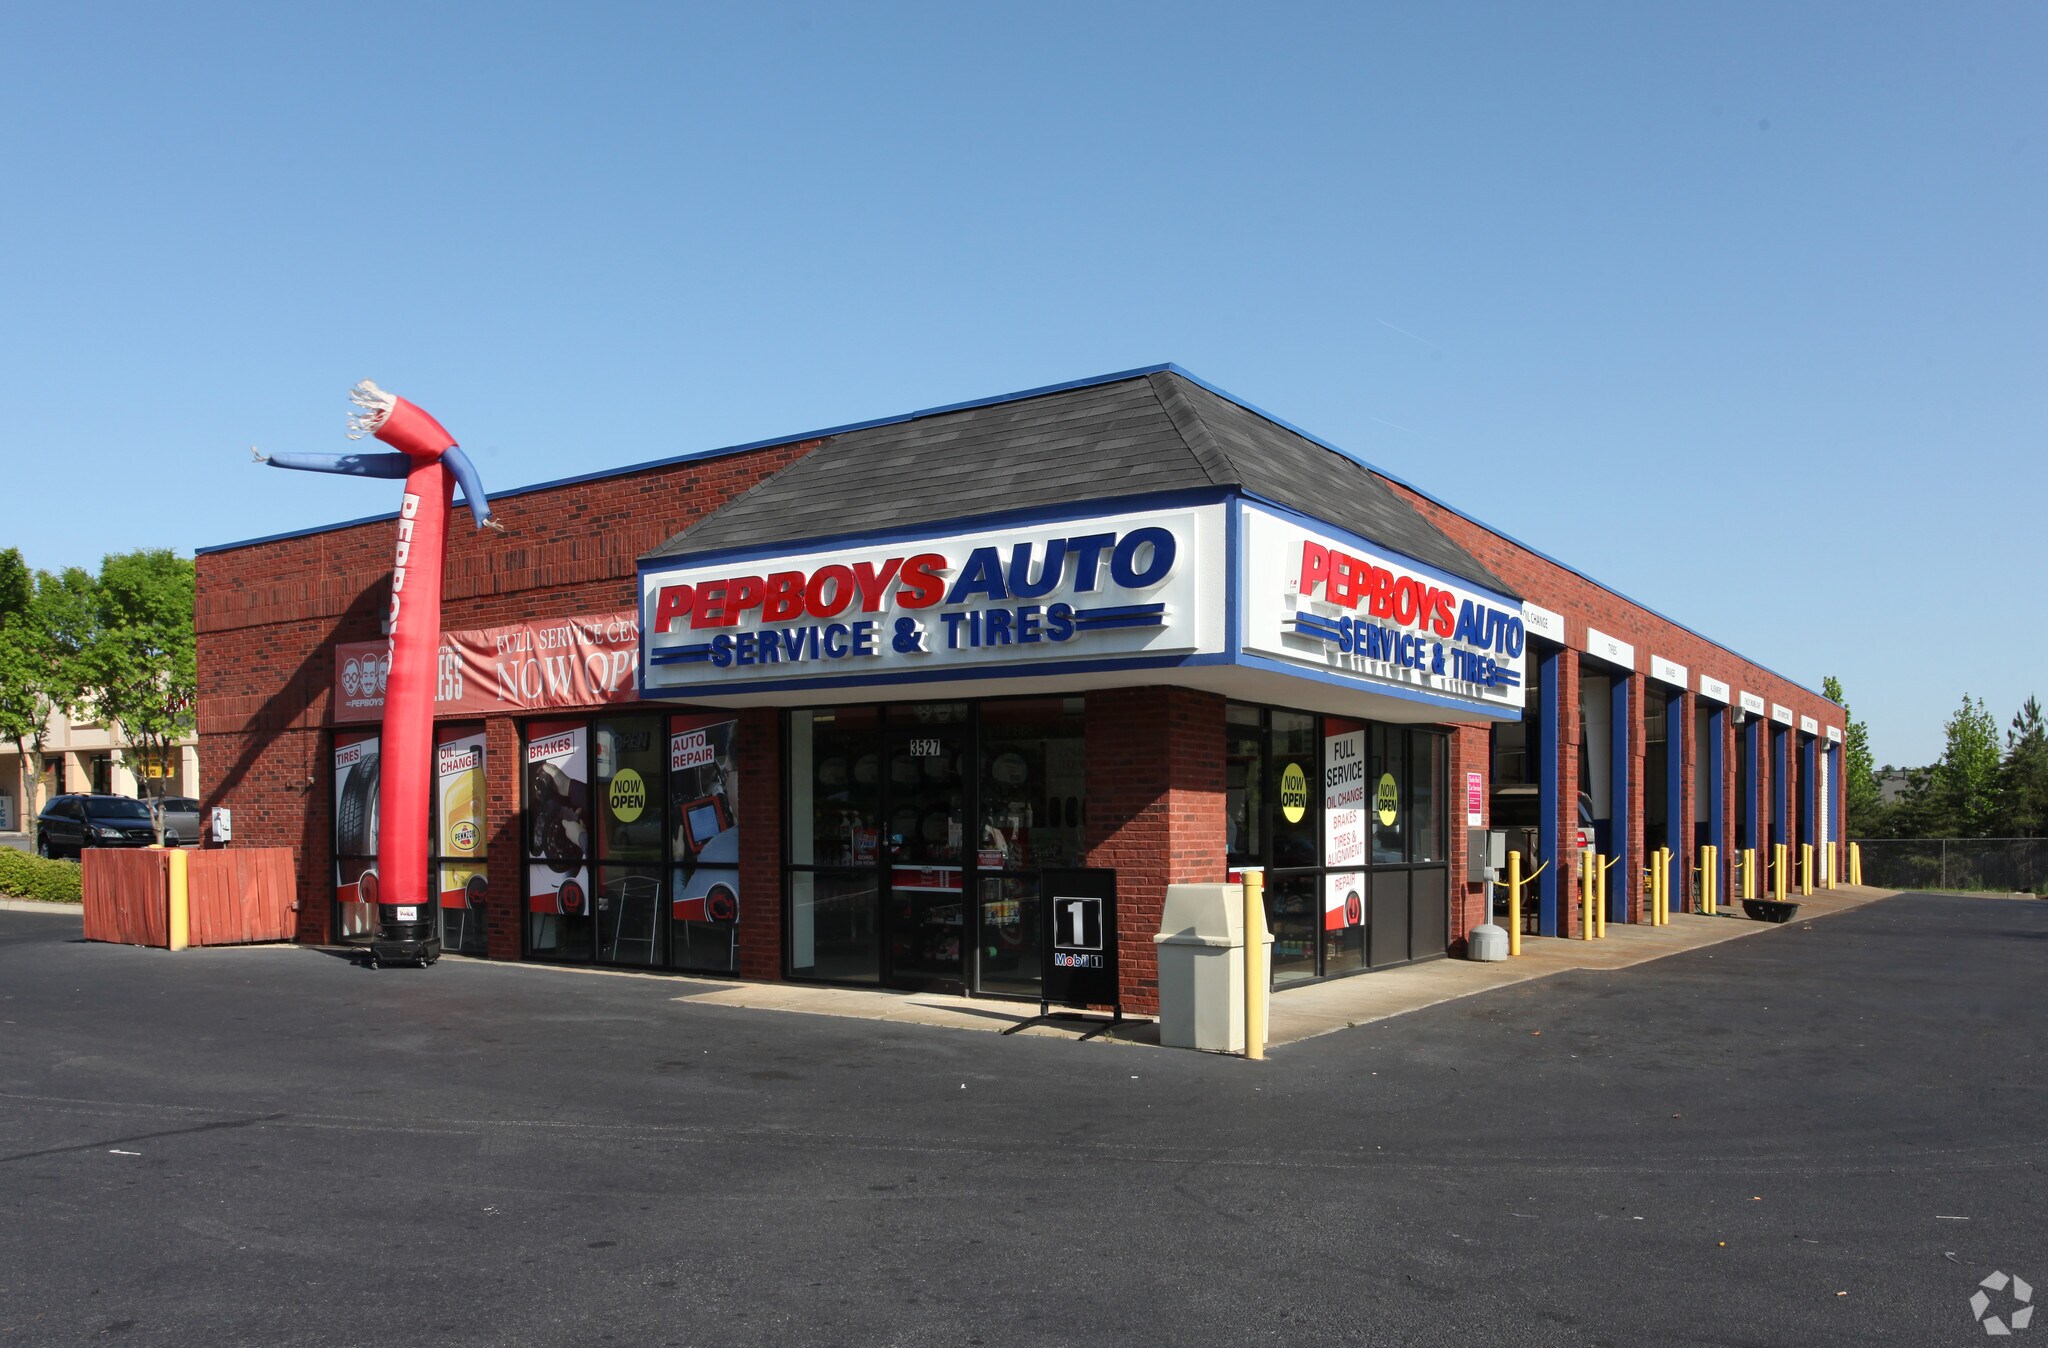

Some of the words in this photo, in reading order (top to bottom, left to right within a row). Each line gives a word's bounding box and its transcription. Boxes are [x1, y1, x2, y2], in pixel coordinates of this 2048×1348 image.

[653, 553, 949, 633] PEPBOYS
[945, 526, 1177, 604] AUTO
[1299, 540, 1456, 638] PEPBOYS
[1454, 599, 1524, 659] AUTO
[1531, 613, 1548, 629] CHANGE
[496, 631, 535, 656] FULL
[539, 624, 603, 650] SERVICE
[607, 620, 639, 643] CEN
[710, 620, 874, 668] SERVICE
[892, 617, 921, 653] &
[940, 603, 1076, 648] TIRES
[1338, 616, 1426, 670] SERVICE
[1432, 643, 1446, 676] &
[1451, 648, 1497, 688] TIRES
[435, 654, 463, 701] ESS
[496, 654, 576, 701] NOW
[584, 648, 639, 694] OP
[351, 698, 384, 708] PEPBOYS
[440, 747, 455, 759] OIL
[530, 737, 571, 759] BRAKES
[673, 734, 704, 753] AUTO
[911, 740, 939, 755] 3527
[1335, 739, 1355, 761] FULL
[337, 749, 359, 765] TIRES
[440, 754, 478, 773] CHANGE
[673, 750, 713, 768] REPAIR
[1285, 776, 1303, 790] NOW
[1327, 761, 1363, 788] SERVICE
[614, 780, 641, 794] NOW
[1381, 784, 1395, 797] NOW
[611, 795, 644, 809] OPEN
[1283, 792, 1305, 807] OPEN
[1327, 794, 1337, 810] OIL
[1338, 787, 1363, 805] CHANGE
[1379, 800, 1396, 812] OPEN
[1333, 810, 1357, 829] BRAKES
[455, 829, 476, 841] PENNZOIL
[1334, 832, 1350, 850] TIRES
[1327, 842, 1363, 866] ALIGNMENT
[1335, 873, 1356, 892] REPAIR
[1067, 902, 1083, 945] 1
[1055, 953, 1089, 967] Mobil
